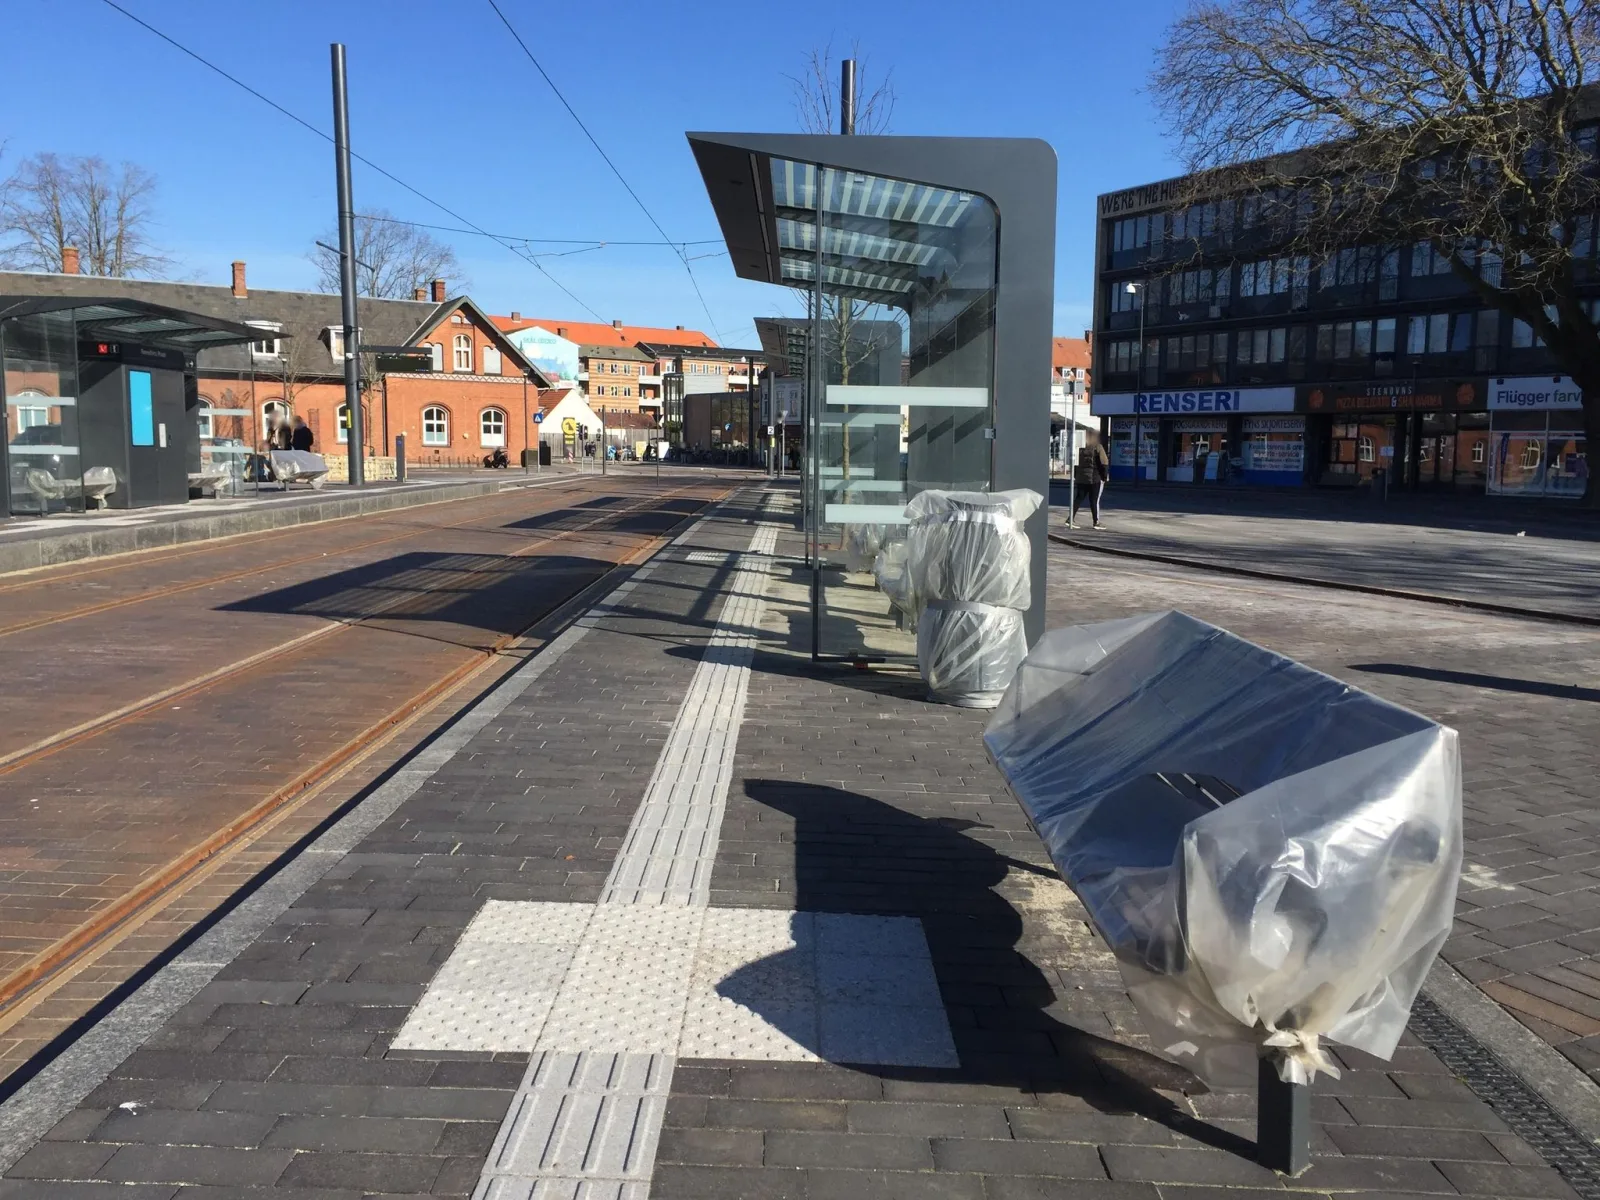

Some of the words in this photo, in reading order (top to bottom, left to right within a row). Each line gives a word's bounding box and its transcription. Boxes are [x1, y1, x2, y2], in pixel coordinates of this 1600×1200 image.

[1137, 186, 1157, 206] THE
[1366, 386, 1412, 396] STENOVNS
[1497, 390, 1550, 406] Flügger
[1553, 389, 1582, 403] farv
[1133, 391, 1240, 412] RENSERI
